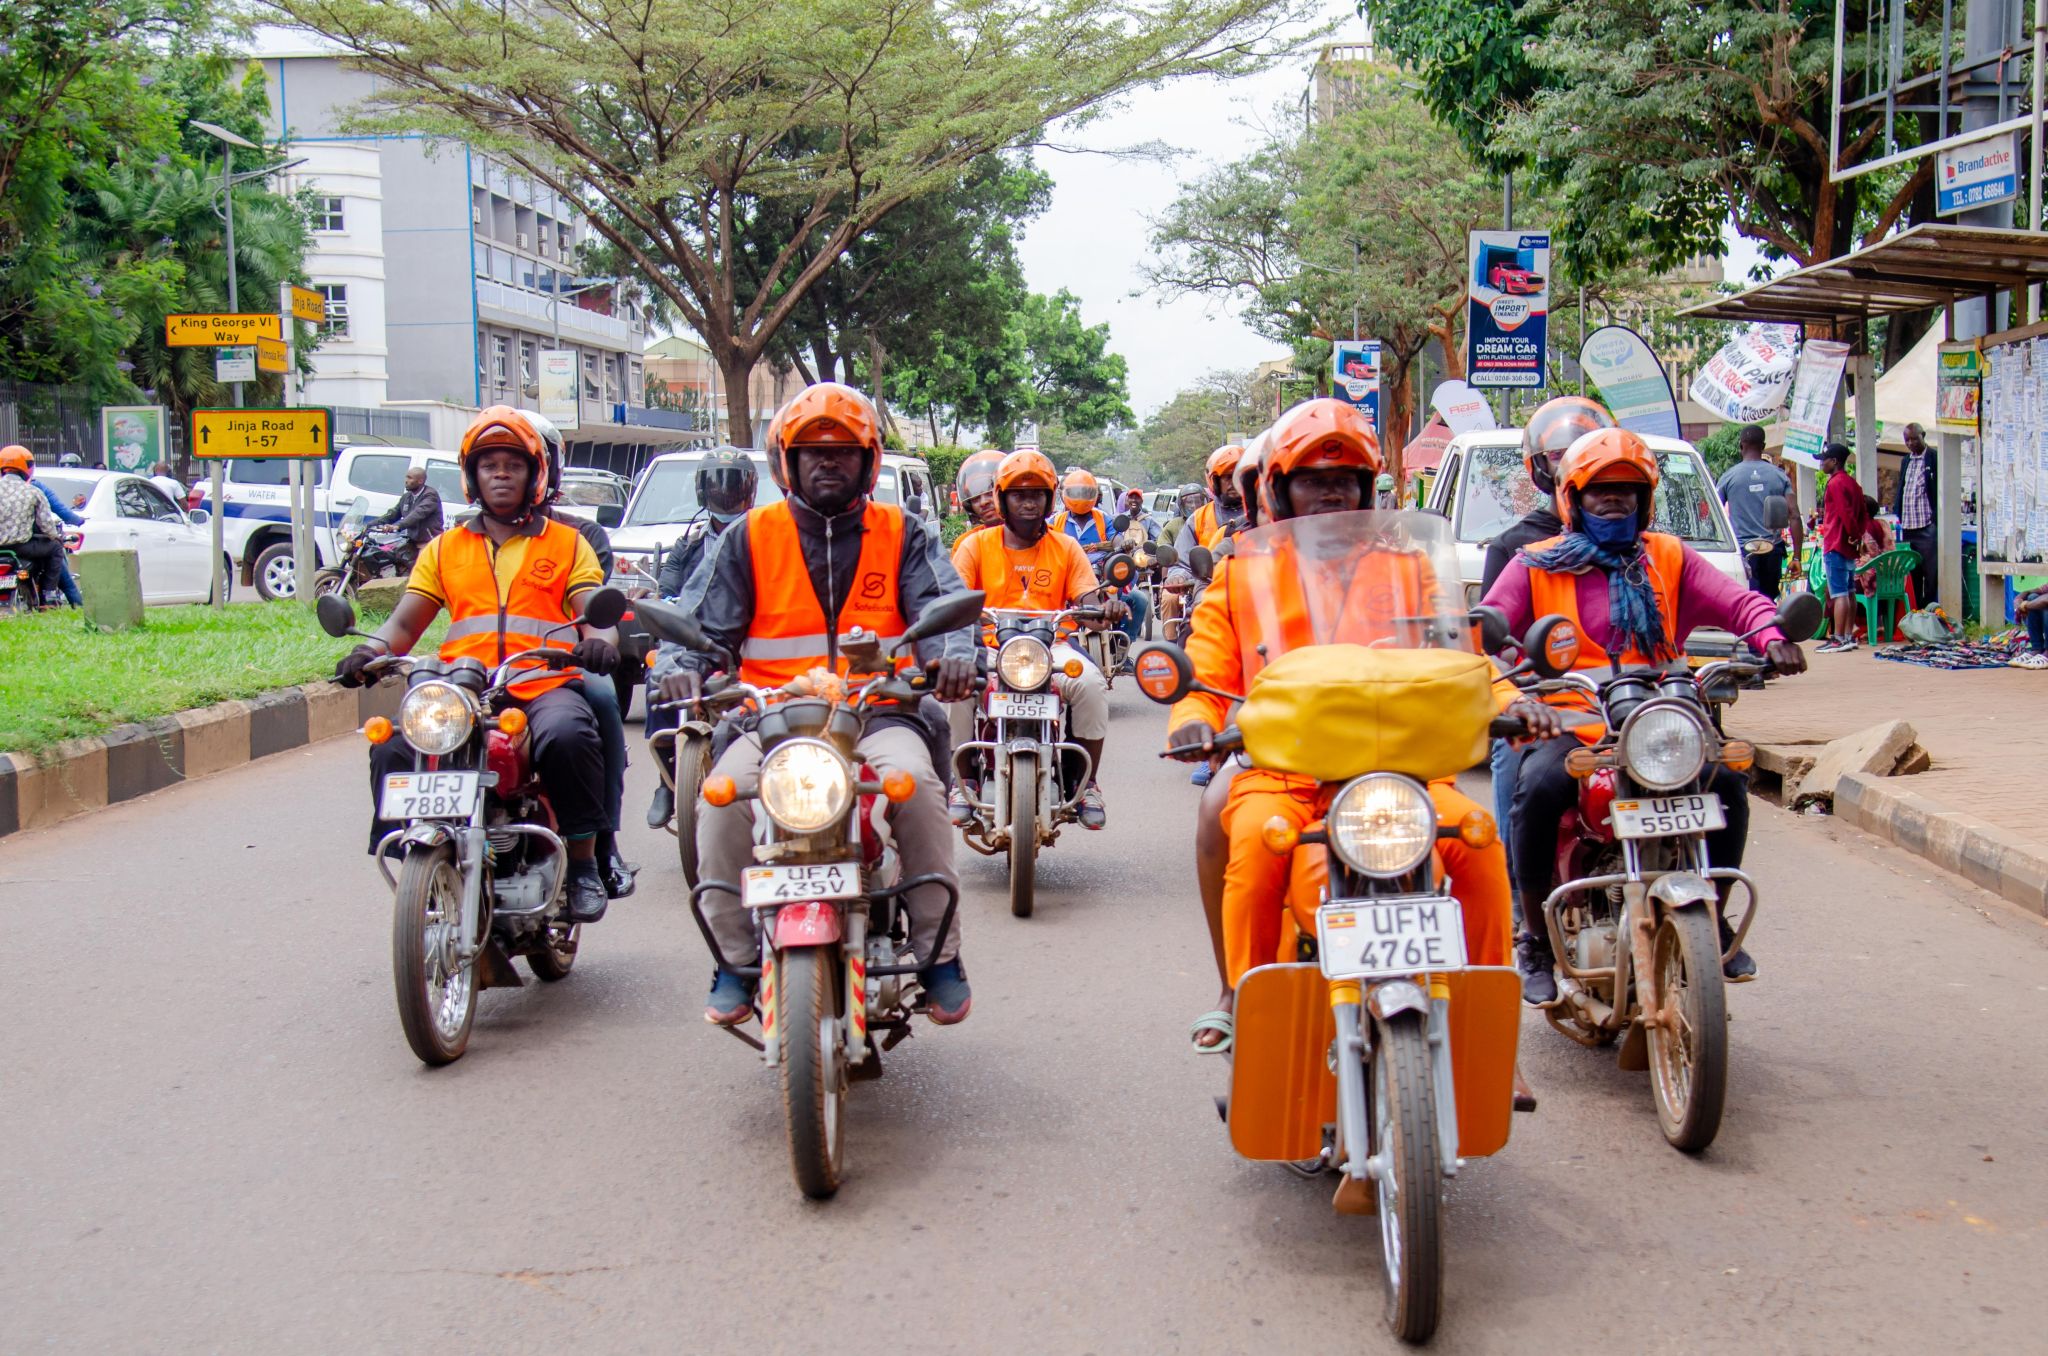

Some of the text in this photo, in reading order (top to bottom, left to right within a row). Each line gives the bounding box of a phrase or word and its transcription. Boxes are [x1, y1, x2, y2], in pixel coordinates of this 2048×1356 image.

[1957, 149, 2010, 174] Brandactive
[1968, 186, 1983, 203] 0782
[306, 298, 322, 314] Road
[1495, 304, 1527, 312] IMPORT
[181, 317, 272, 329] King George VI
[214, 332, 240, 343] Way
[1476, 344, 1538, 354] DREAM CAR
[227, 420, 294, 432] Jinja Road
[244, 435, 278, 447] 1-57
[248, 489, 277, 500] WATER
[1012, 694, 1045, 704] UFJ
[417, 774, 464, 794] UFJ
[403, 795, 462, 816] 788X
[1652, 796, 1704, 814] UFD
[787, 866, 842, 880] UFA
[774, 880, 845, 898] 435V
[1372, 905, 1440, 935] UFM
[1360, 937, 1446, 969] 476E
